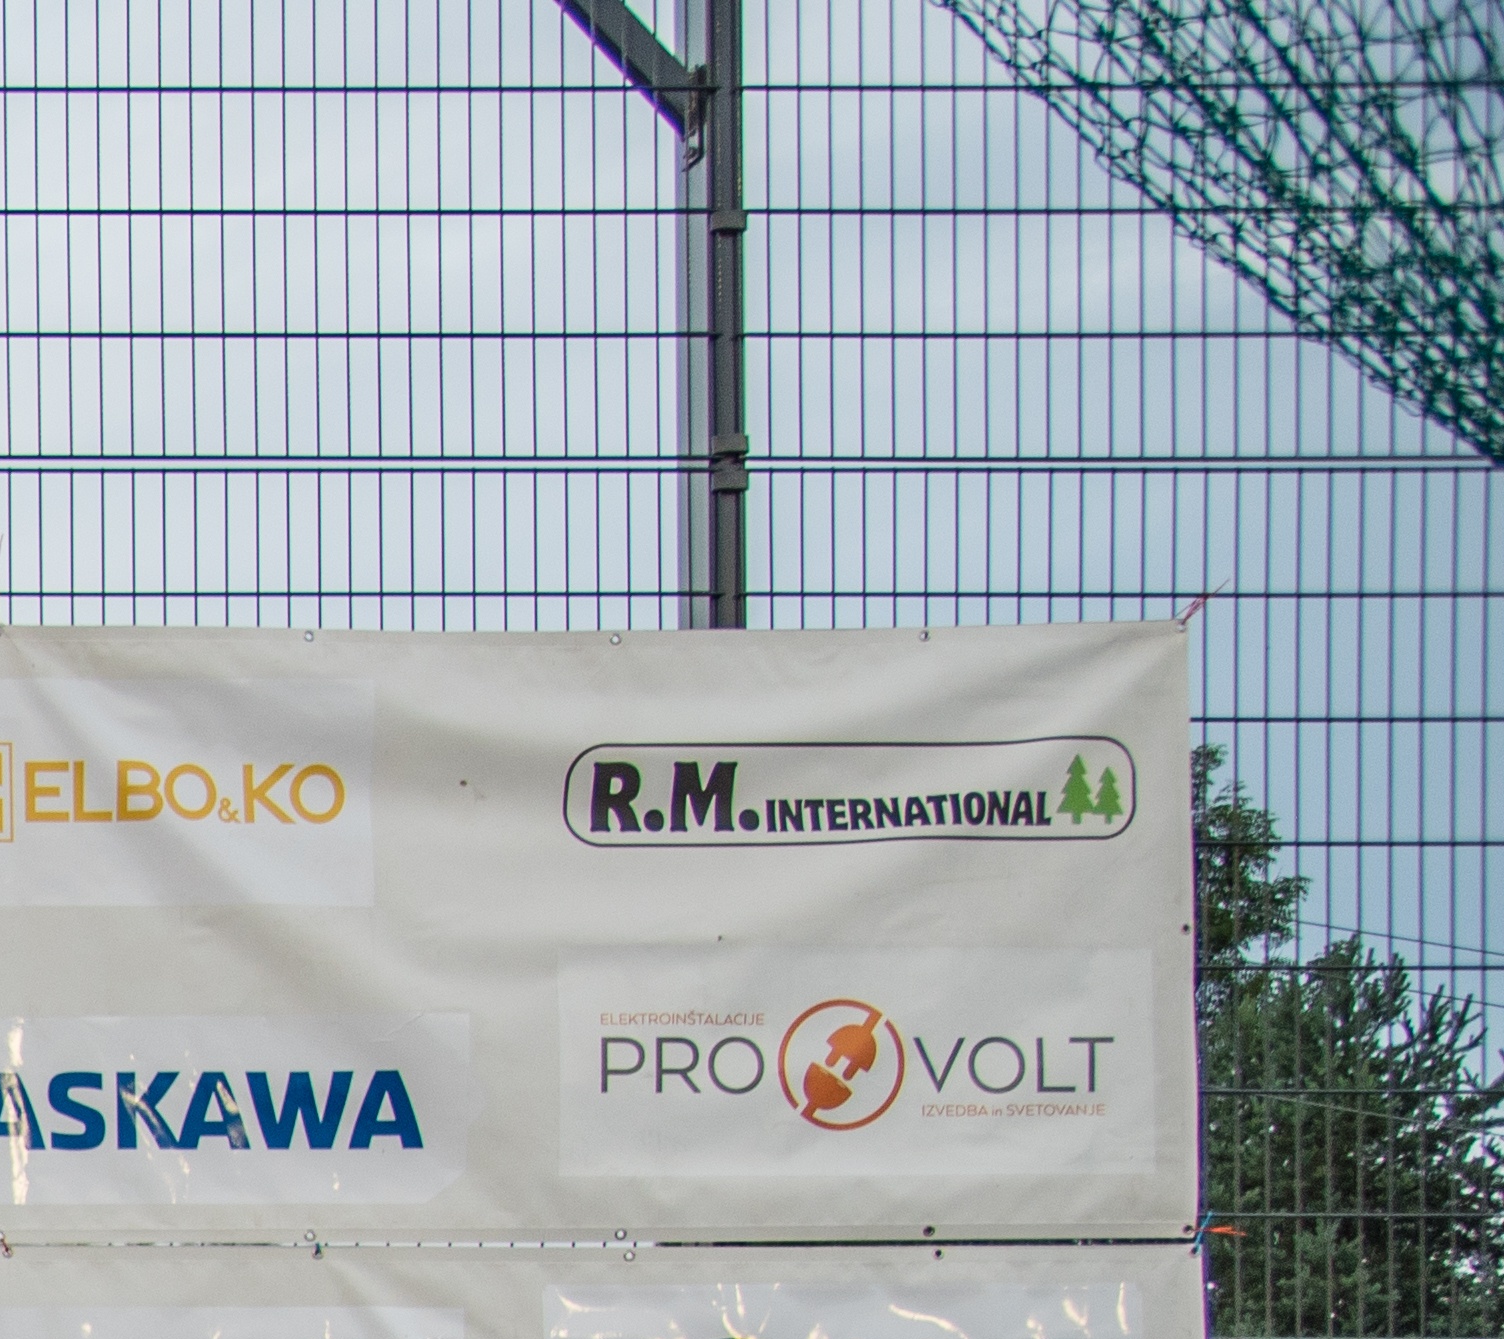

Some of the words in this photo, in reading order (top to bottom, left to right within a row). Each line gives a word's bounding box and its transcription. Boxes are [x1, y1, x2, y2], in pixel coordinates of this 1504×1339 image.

[23, 760, 346, 826] ELBO&KO
[765, 790, 1052, 834] INTERNATIONAL
[599, 1008, 766, 1027] ELEKTROINŠTALACIJE
[921, 1103, 990, 1118] IZVEDBA
[1006, 1103, 1106, 1118] SVETOVANJE
